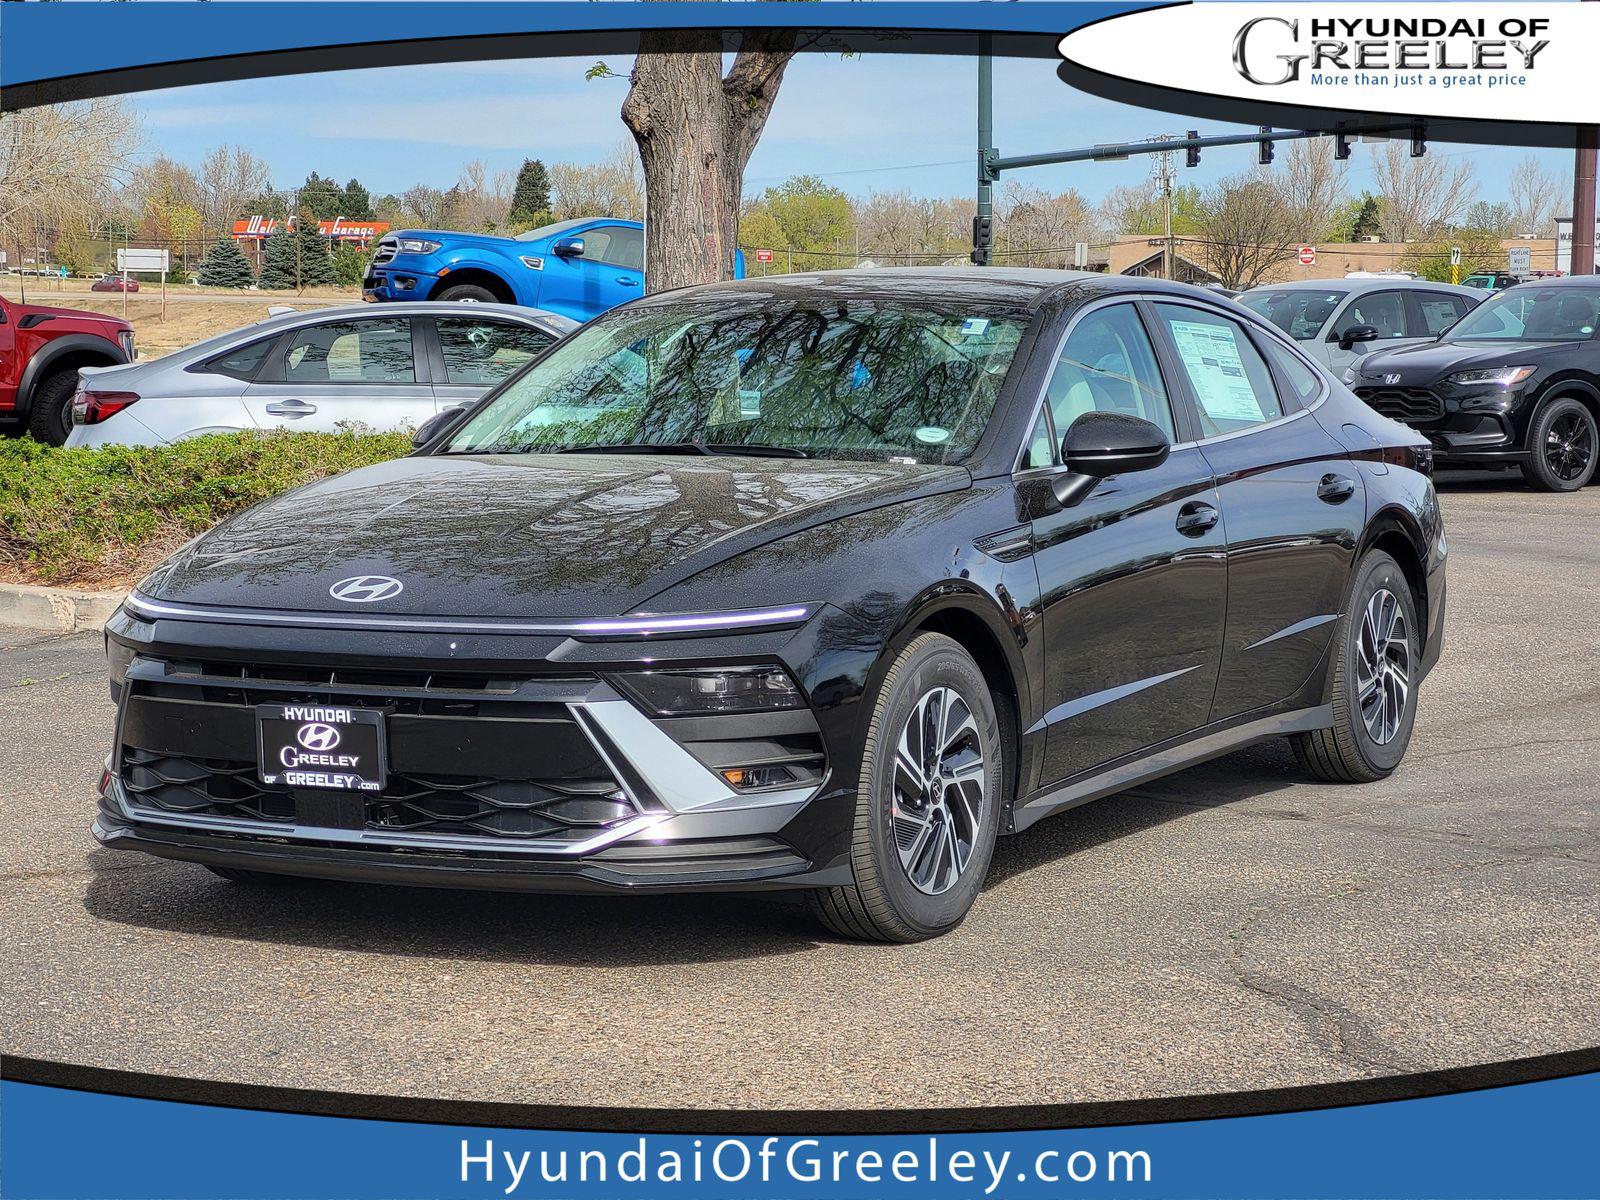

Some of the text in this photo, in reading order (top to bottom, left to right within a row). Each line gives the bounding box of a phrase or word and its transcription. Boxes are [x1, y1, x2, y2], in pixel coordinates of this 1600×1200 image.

[332, 216, 374, 237] Garage
[284, 706, 351, 723] HYUNDAI
[280, 746, 359, 767] GREELEY
[264, 772, 380, 790] OF GREELEY .com
